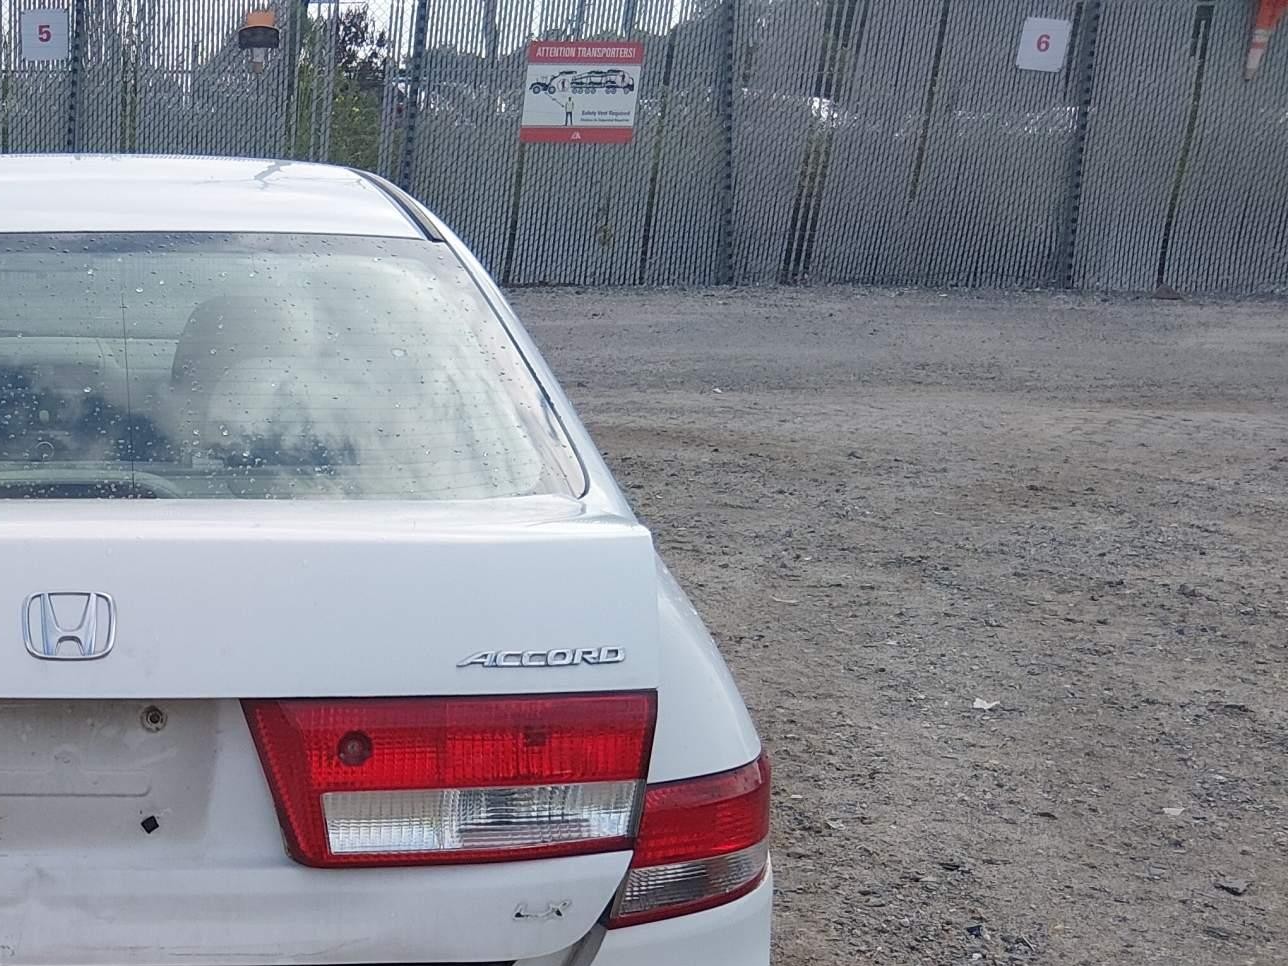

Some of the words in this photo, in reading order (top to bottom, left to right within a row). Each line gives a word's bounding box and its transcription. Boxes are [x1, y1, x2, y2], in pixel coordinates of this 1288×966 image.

[38, 24, 52, 43] 5
[1036, 33, 1051, 53] 6
[535, 46, 576, 58] ATTENTION
[578, 47, 636, 59] TRANSPORTERS!
[456, 646, 625, 668] ACCORD
[512, 899, 572, 920] LX
